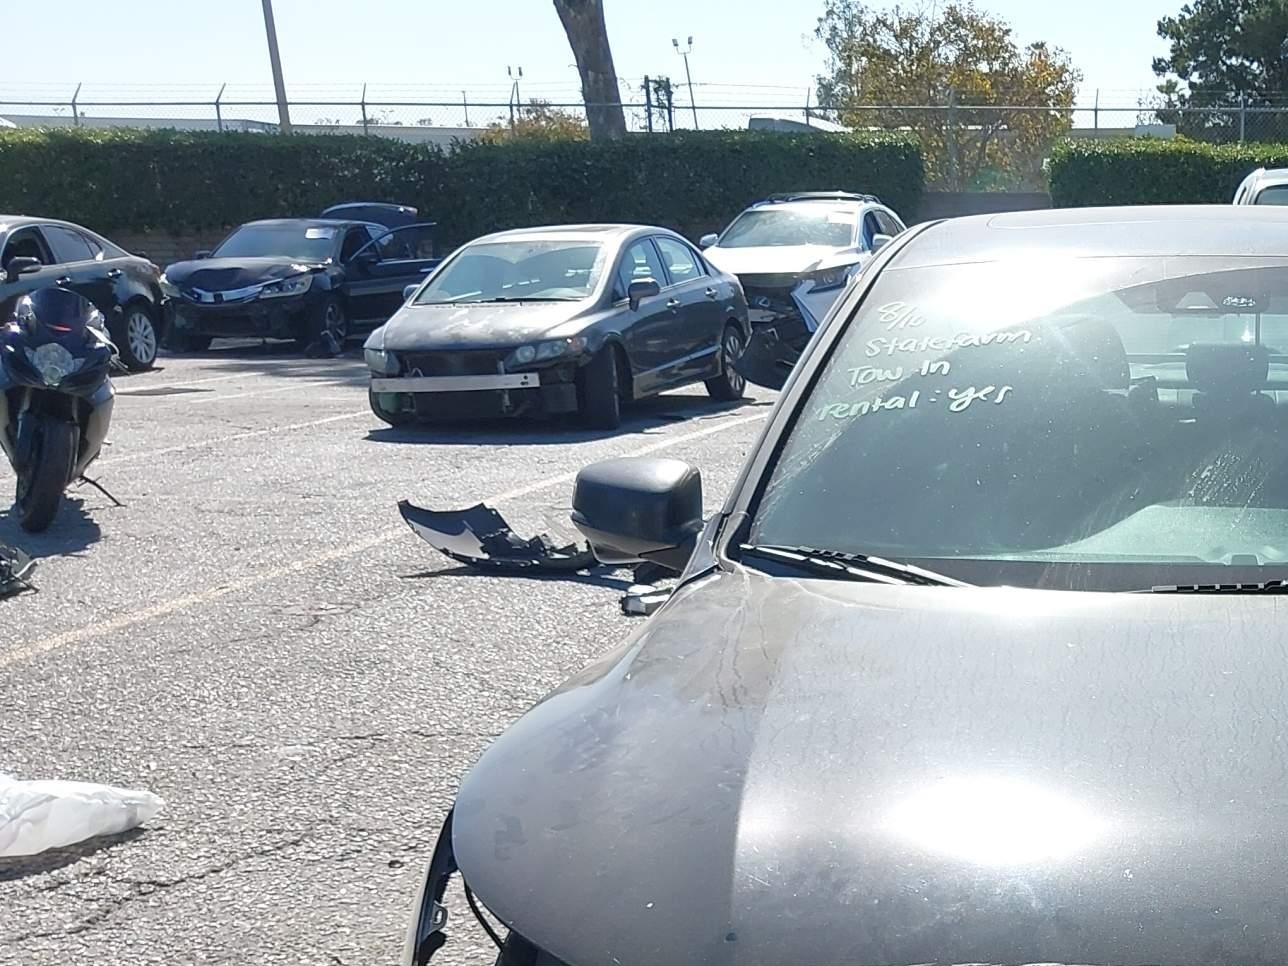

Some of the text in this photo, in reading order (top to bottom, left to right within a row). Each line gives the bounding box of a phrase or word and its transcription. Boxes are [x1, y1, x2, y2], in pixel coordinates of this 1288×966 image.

[847, 359, 951, 387] Tow In
[947, 384, 1013, 412] yes
